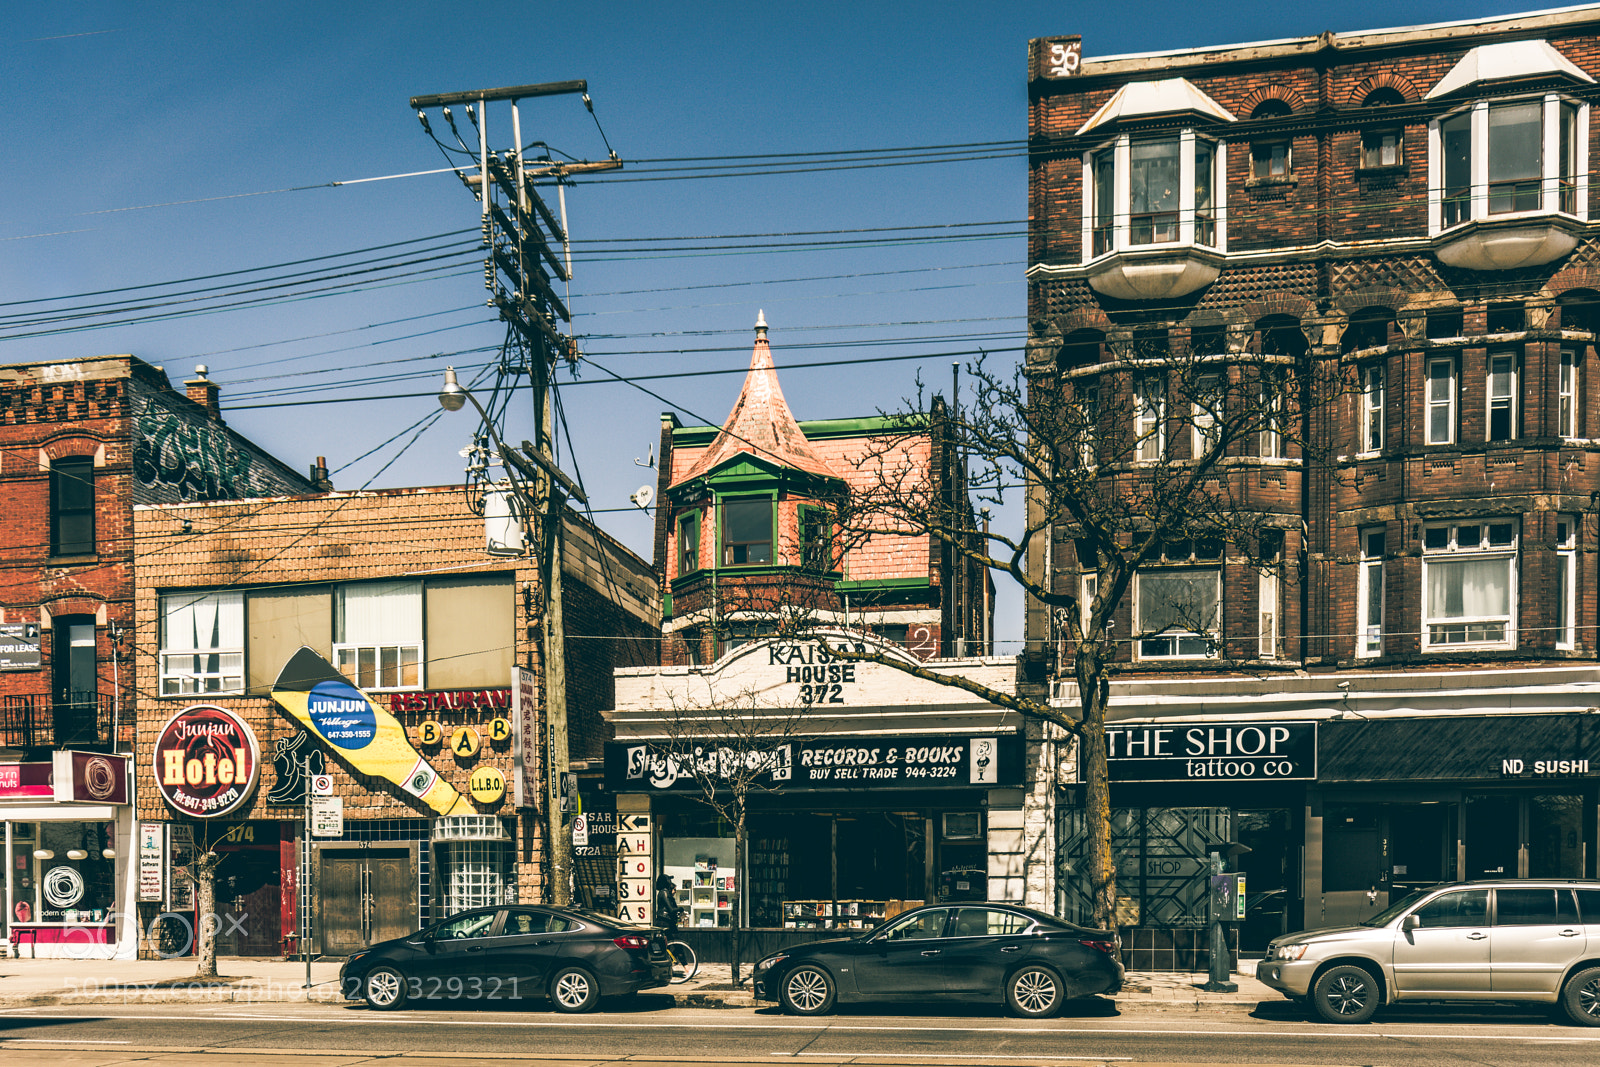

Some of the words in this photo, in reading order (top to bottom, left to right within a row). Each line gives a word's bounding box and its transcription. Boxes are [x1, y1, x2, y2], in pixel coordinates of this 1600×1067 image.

[0, 645, 14, 653] FOR
[15, 644, 39, 652] LEASE
[521, 671, 532, 682] 374
[786, 664, 855, 683] HOUSE
[800, 684, 844, 704] 372
[309, 700, 366, 713] JUNJUN
[318, 716, 361, 728] Village
[174, 720, 235, 748] Junjun
[327, 730, 371, 738] 647-350-1555
[1105, 729, 1174, 757] THE
[1185, 727, 1290, 755] SHOP
[801, 748, 880, 766] RECORDS
[885, 748, 898, 764] &
[904, 746, 964, 763] BOOKS
[162, 747, 247, 786] Hotel
[809, 768, 831, 780] BUY
[834, 768, 859, 779] SELL
[862, 767, 898, 779] TRADE
[905, 766, 957, 778] 944-3224
[1186, 758, 1255, 777] tattoo
[1263, 760, 1293, 776] co
[1502, 759, 1524, 775] ND
[1534, 759, 1589, 774] SUSHI
[471, 777, 503, 792] L.L.B.O.
[227, 826, 254, 842] 374
[575, 846, 601, 856] 372A
[1148, 861, 1181, 875] SHOP
